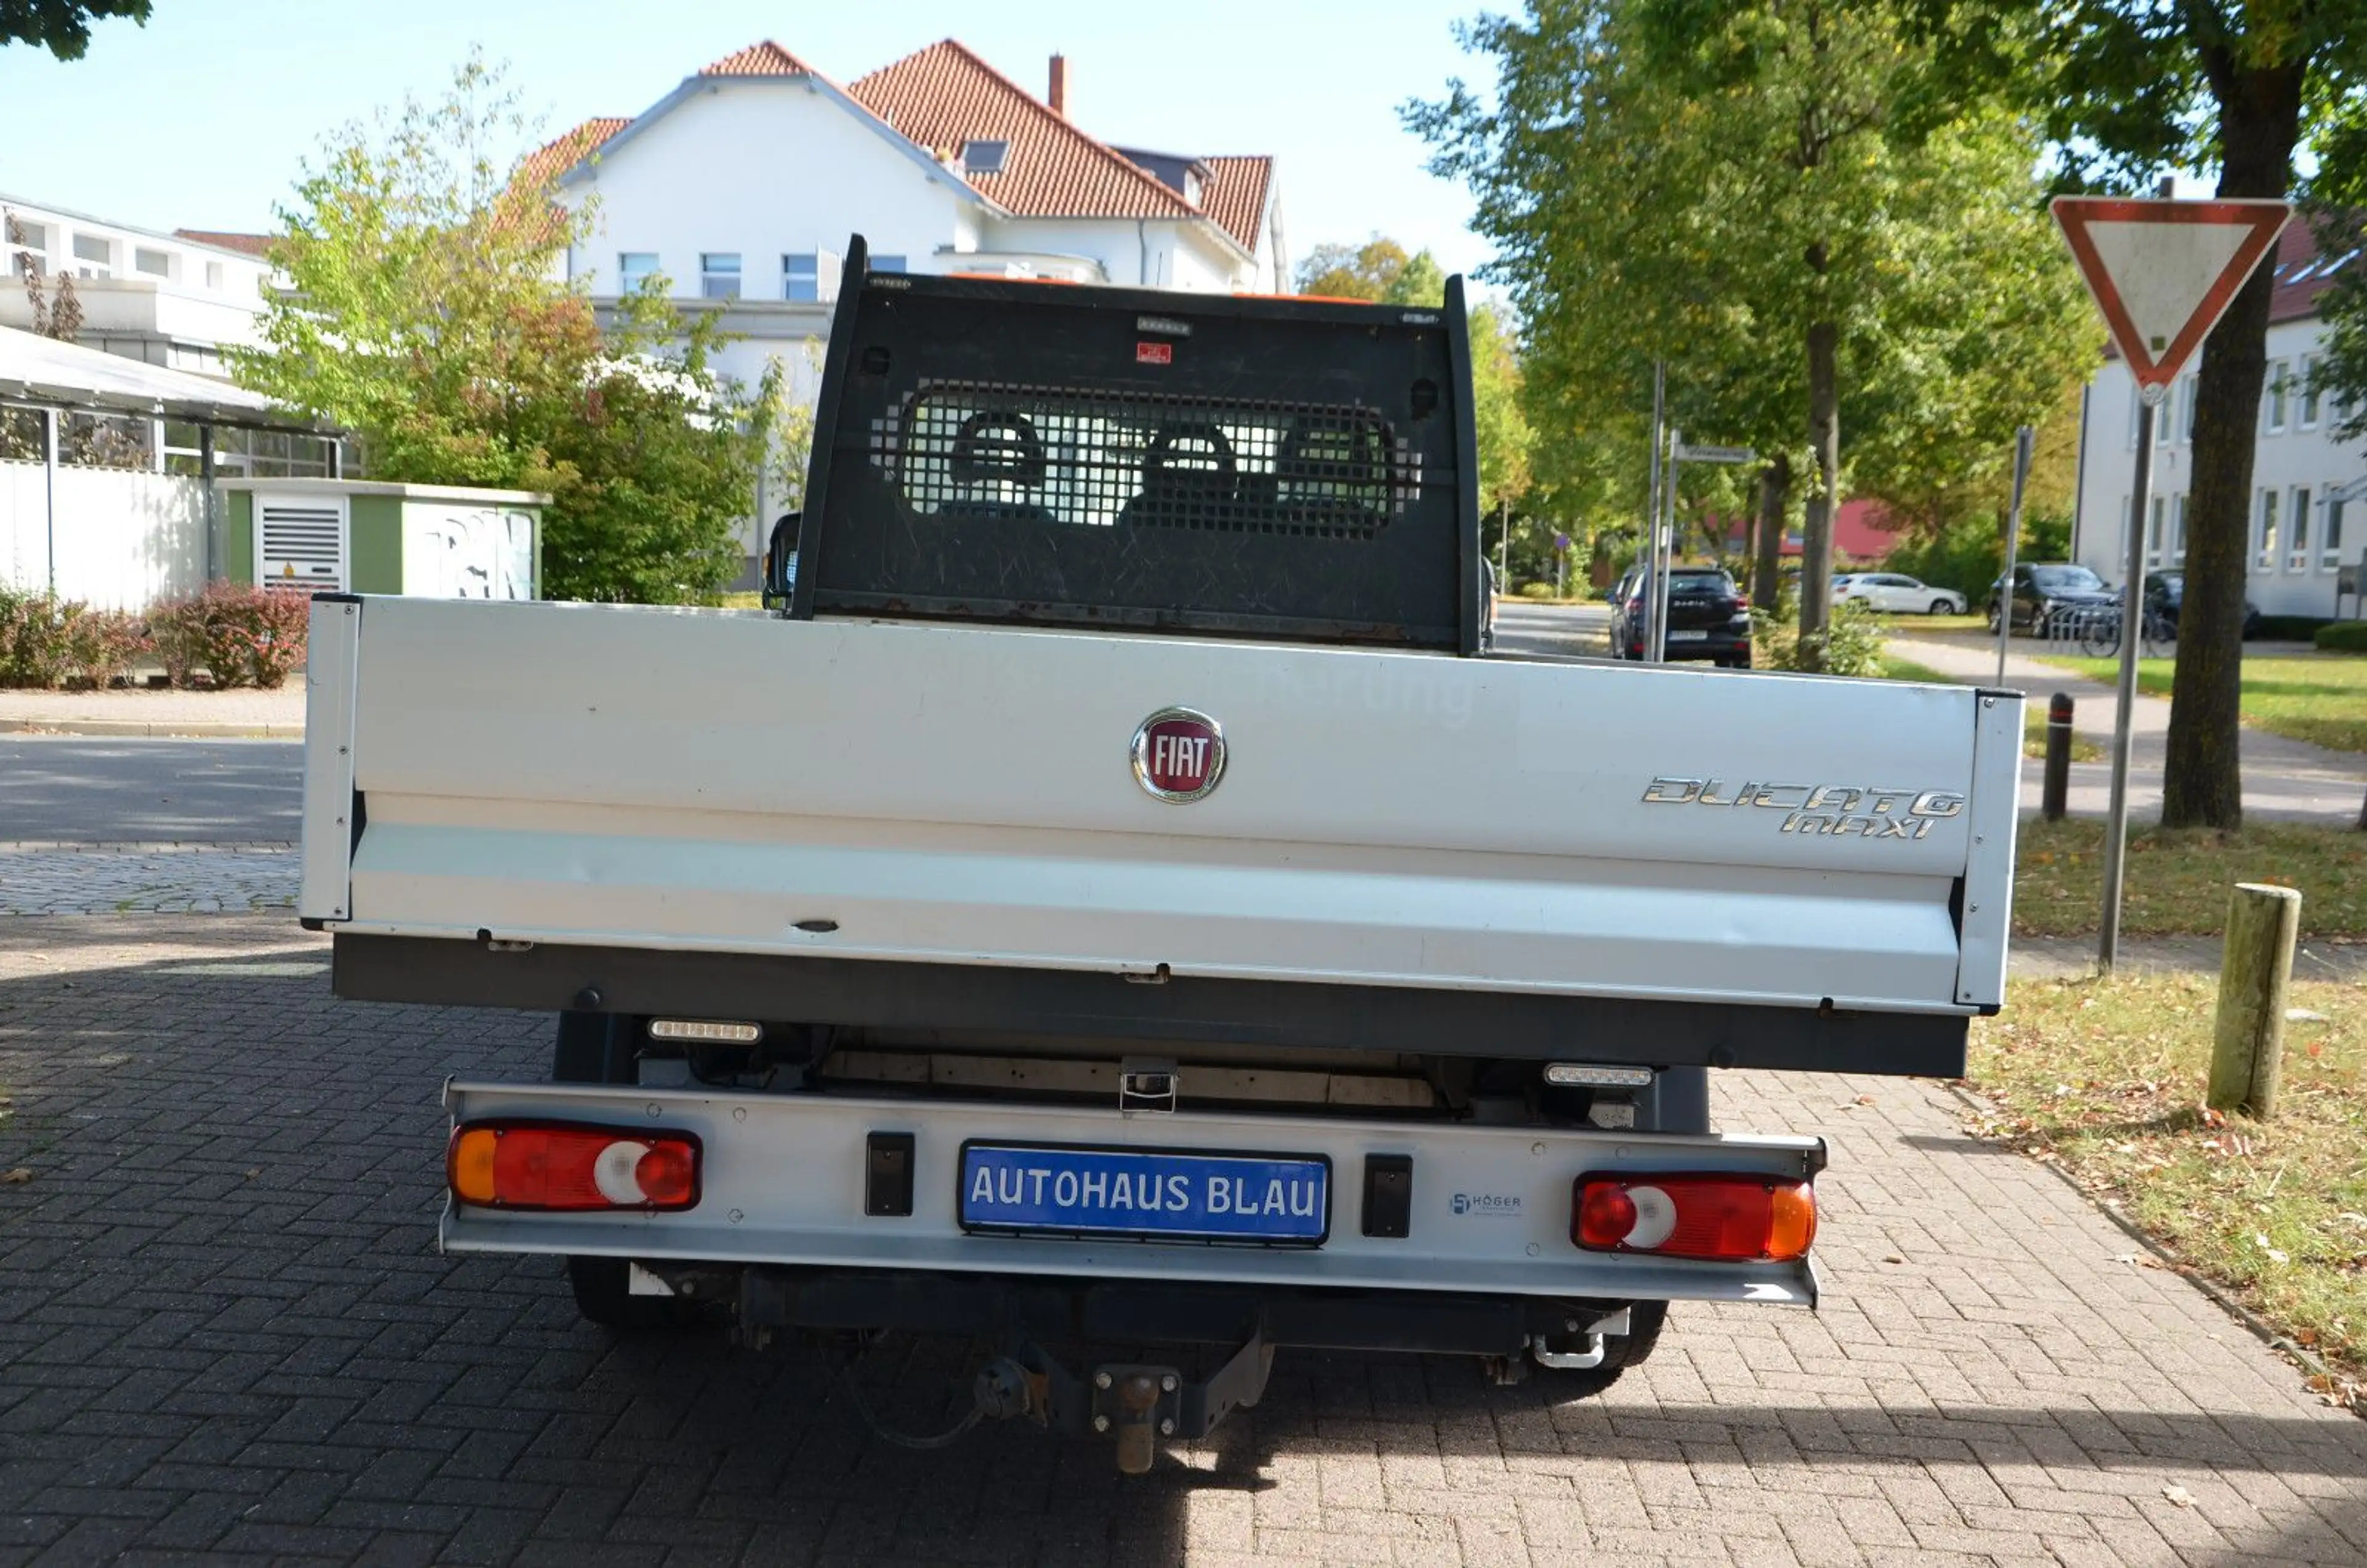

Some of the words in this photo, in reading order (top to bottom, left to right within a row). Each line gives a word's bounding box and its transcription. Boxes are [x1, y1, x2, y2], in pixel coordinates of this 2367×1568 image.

[1155, 735, 1209, 778] FIAT
[1642, 776, 1965, 817] DUCATO
[971, 1166, 1190, 1212] AUTOHAUS
[1205, 1175, 1315, 1217] BLAU
